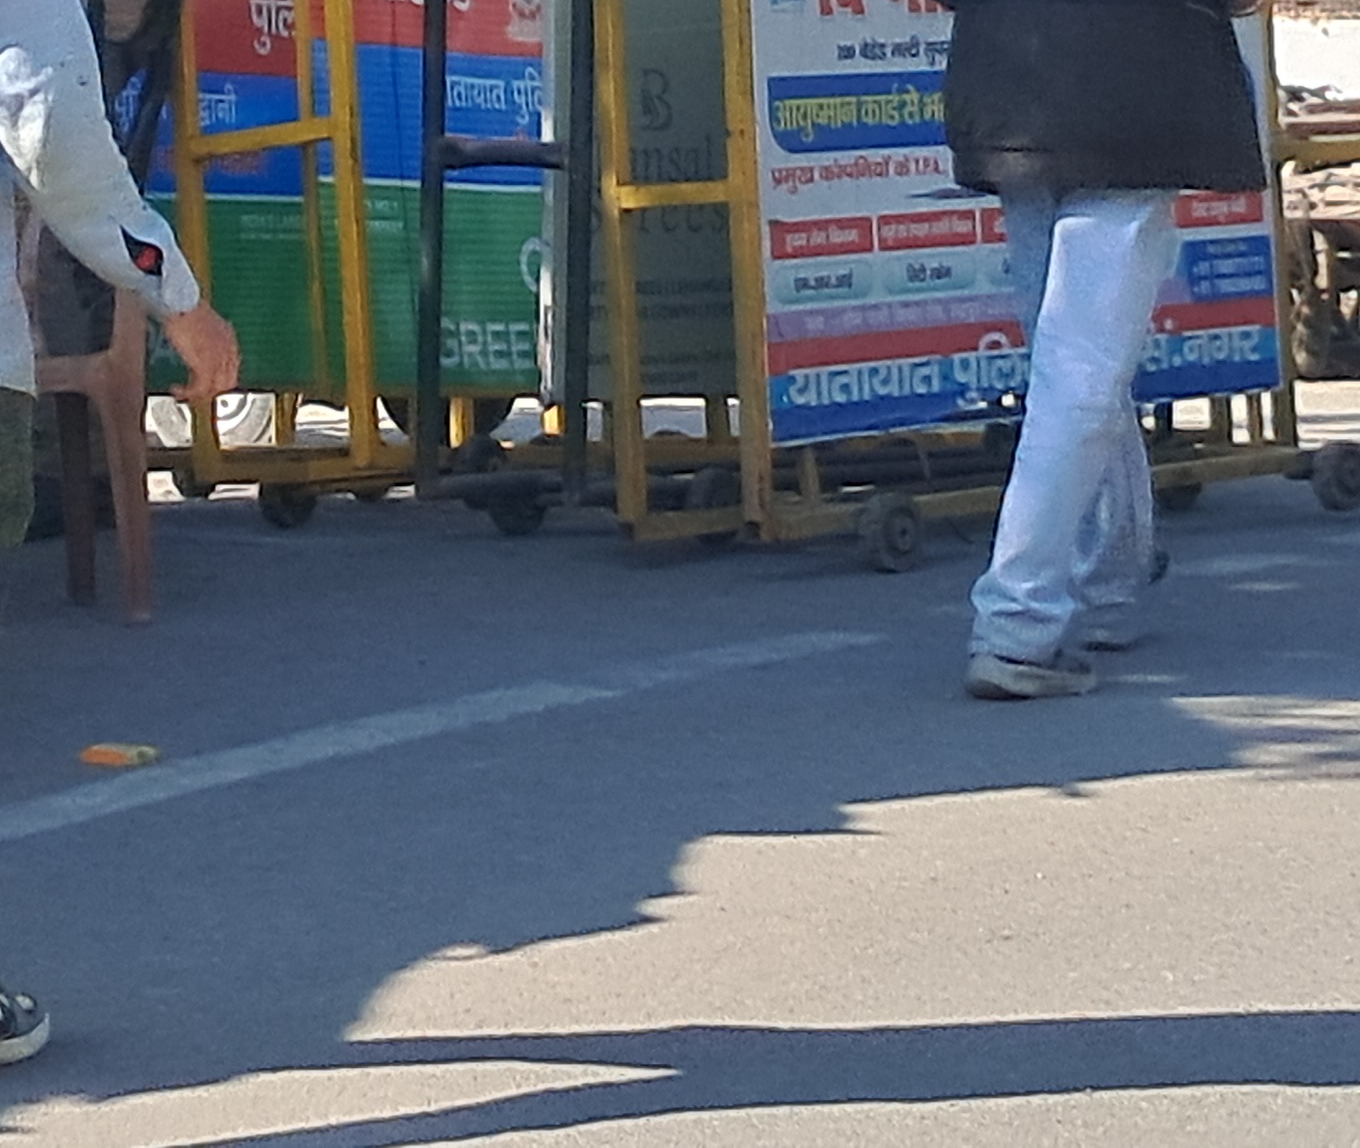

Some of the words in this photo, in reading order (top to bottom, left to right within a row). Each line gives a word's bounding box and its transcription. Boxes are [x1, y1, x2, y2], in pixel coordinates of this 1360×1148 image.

[771, 97, 857, 142] आयुष्मान
[440, 317, 536, 370] GREE
[788, 355, 942, 407] यातायात
